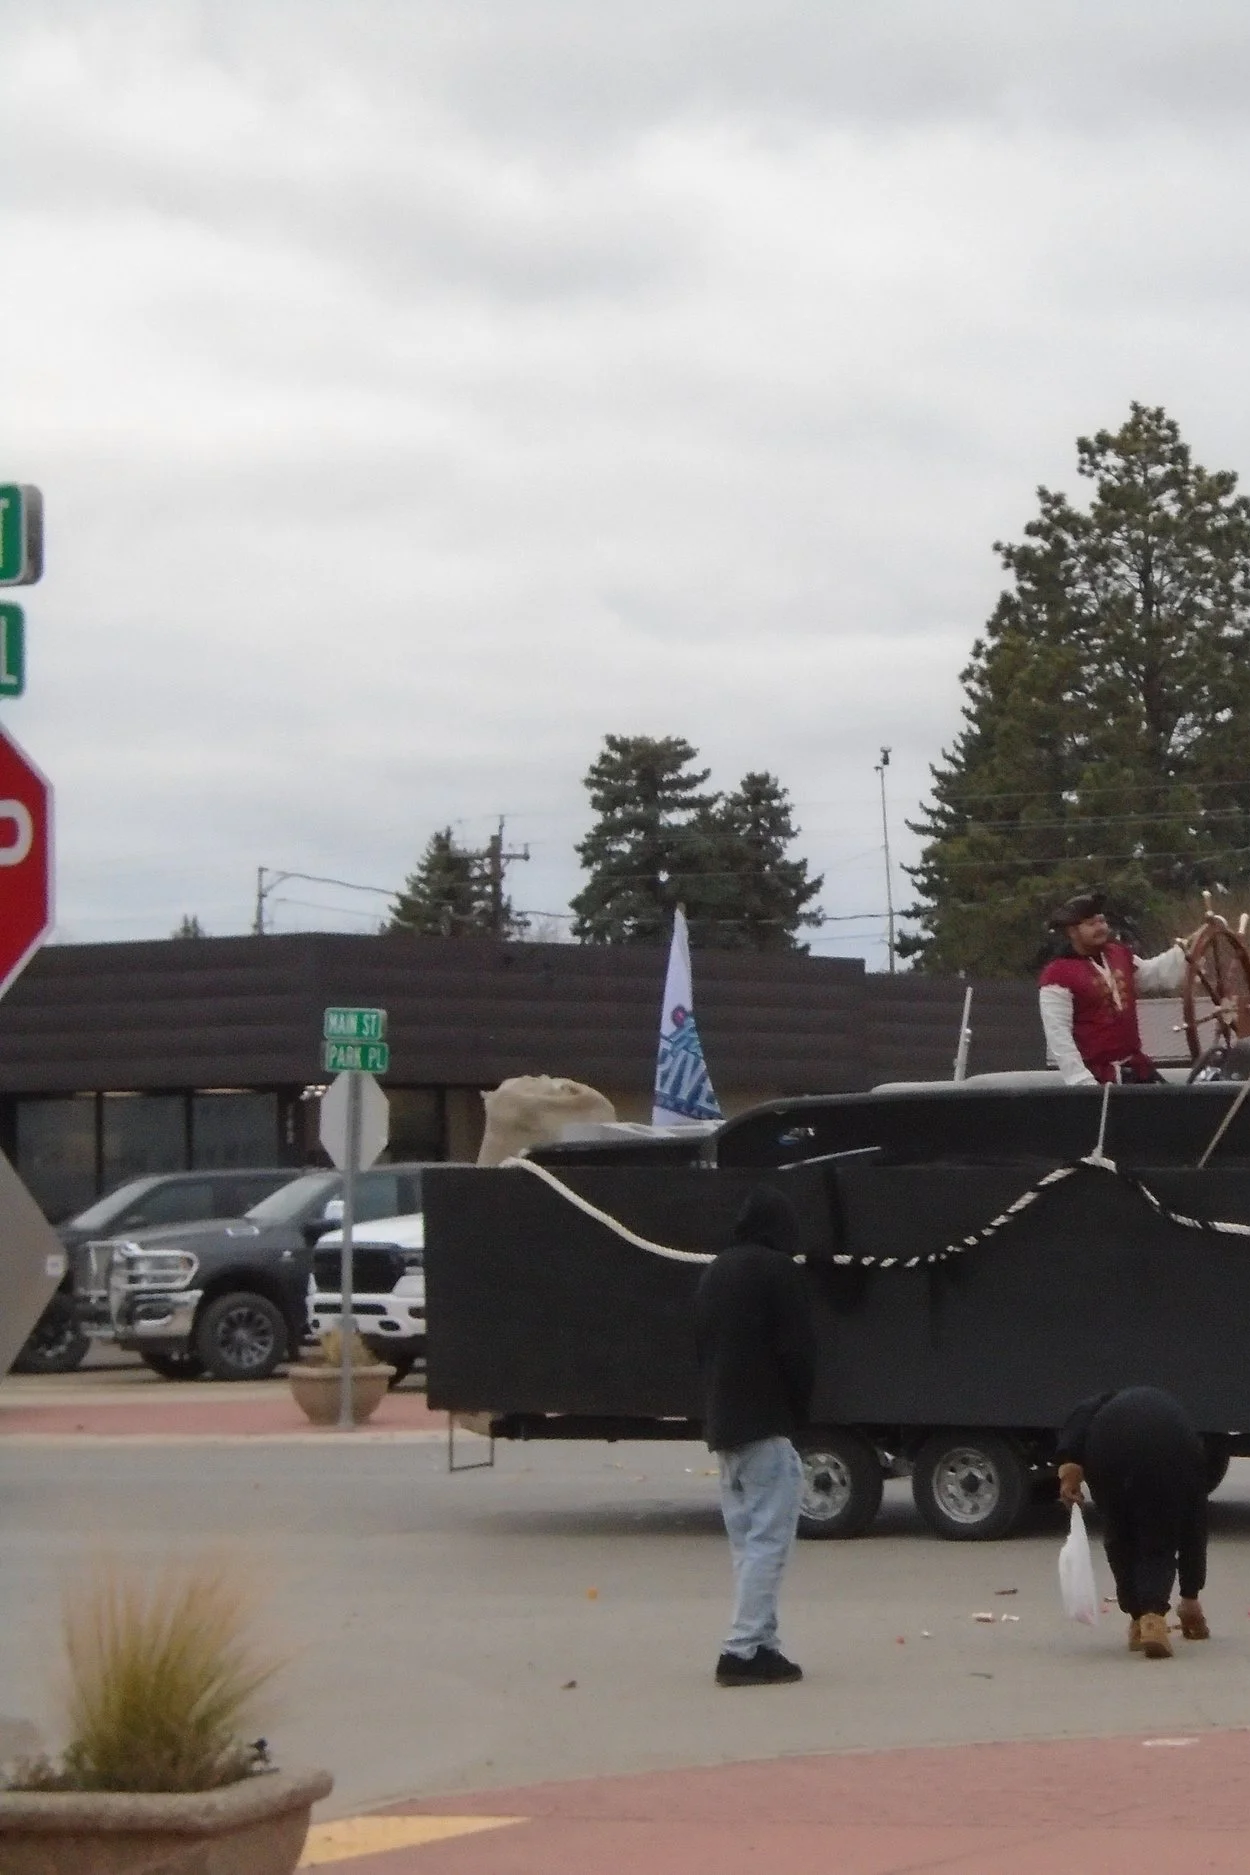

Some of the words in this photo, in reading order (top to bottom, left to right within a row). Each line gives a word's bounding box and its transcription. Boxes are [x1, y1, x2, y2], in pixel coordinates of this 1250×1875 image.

[328, 1013, 358, 1035] MAIN
[362, 1014, 377, 1037] ST
[329, 1045, 361, 1068] PARK
[368, 1047, 385, 1069] PL
